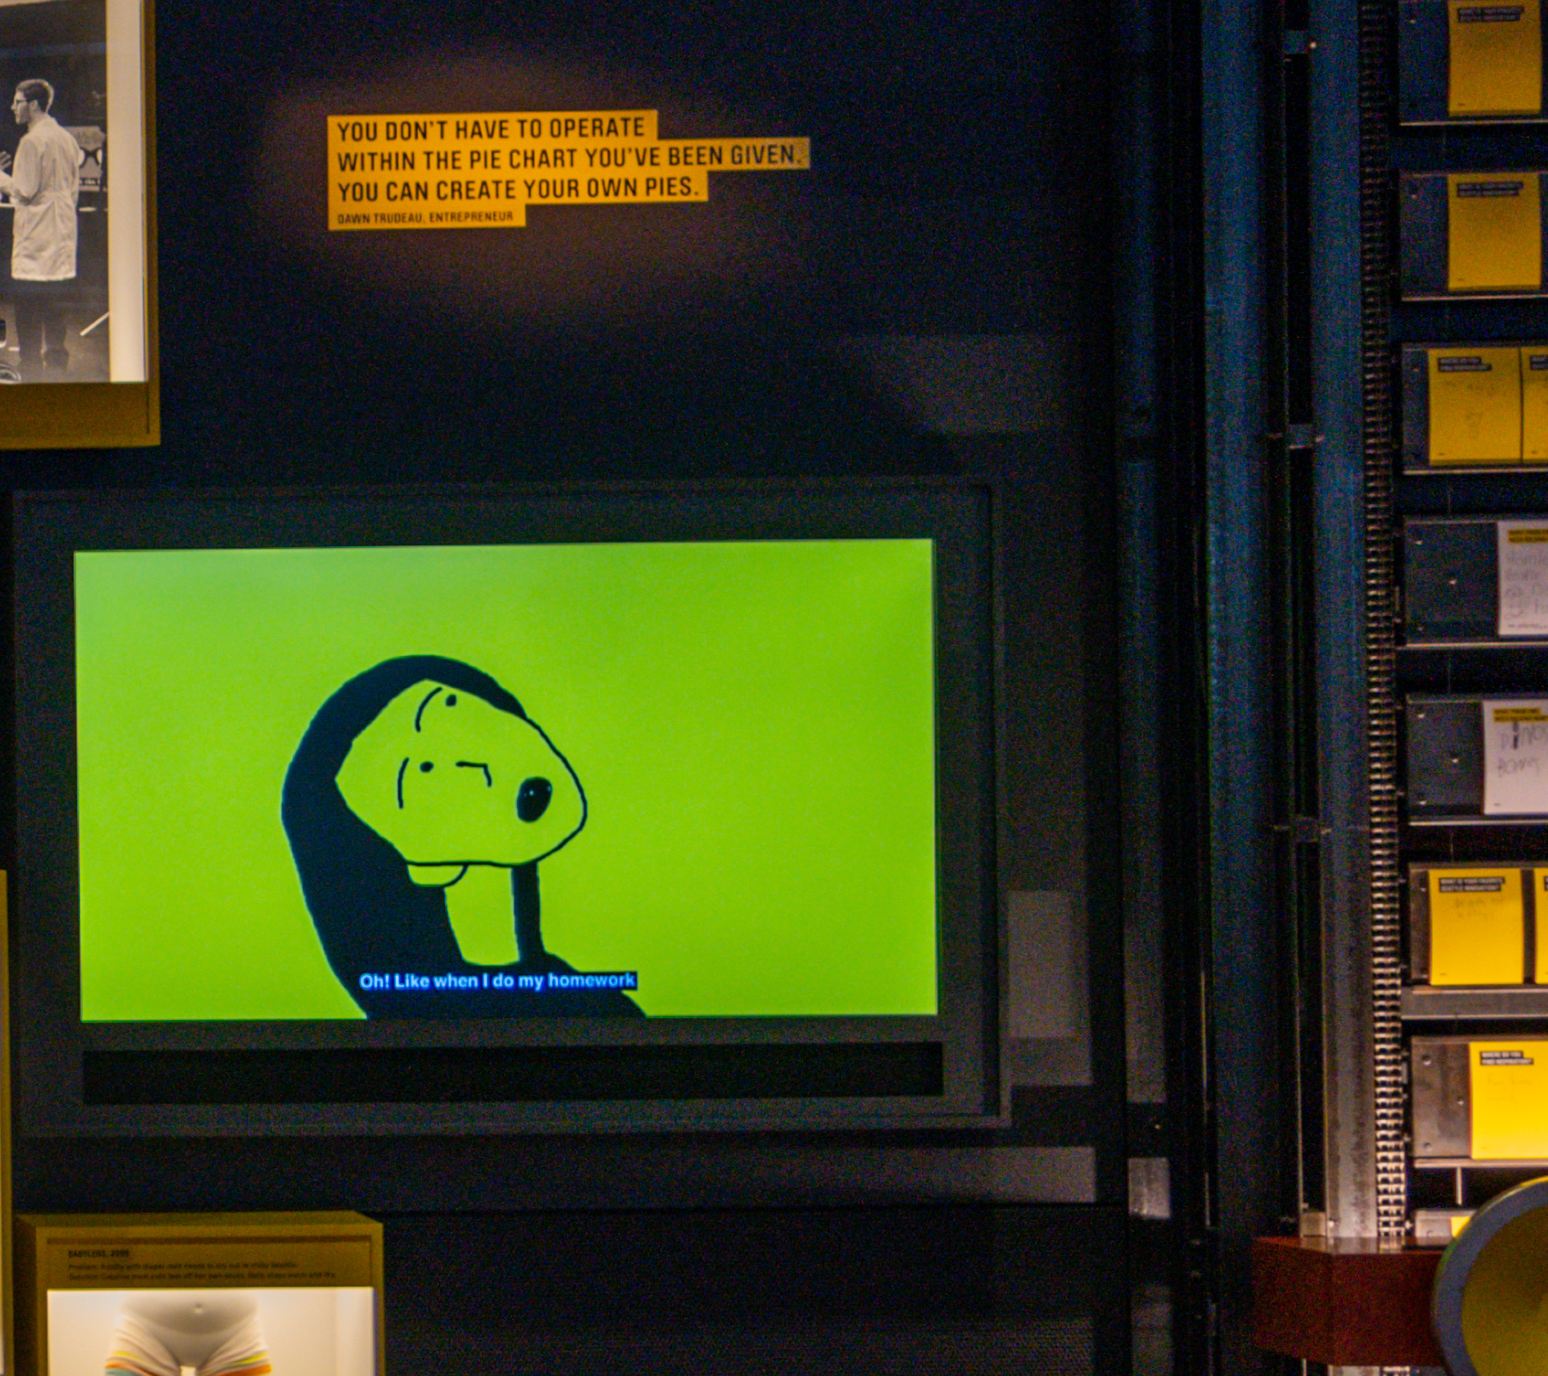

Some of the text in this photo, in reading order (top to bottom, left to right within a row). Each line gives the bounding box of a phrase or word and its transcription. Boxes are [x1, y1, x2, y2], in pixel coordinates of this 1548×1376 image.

[338, 116, 645, 143] YOU DON'T HAVE TO OPERATE
[337, 144, 804, 171] WITHIN THE PIE CHART YOU'VE BEEN GIVEN.
[337, 175, 700, 202] YOU CAN CREATE YOUR OWN PIES.
[338, 211, 513, 226] DAWN TRUDEAU, ENTREPRENEUR
[360, 971, 636, 993] Oh! Like when I do my homework
